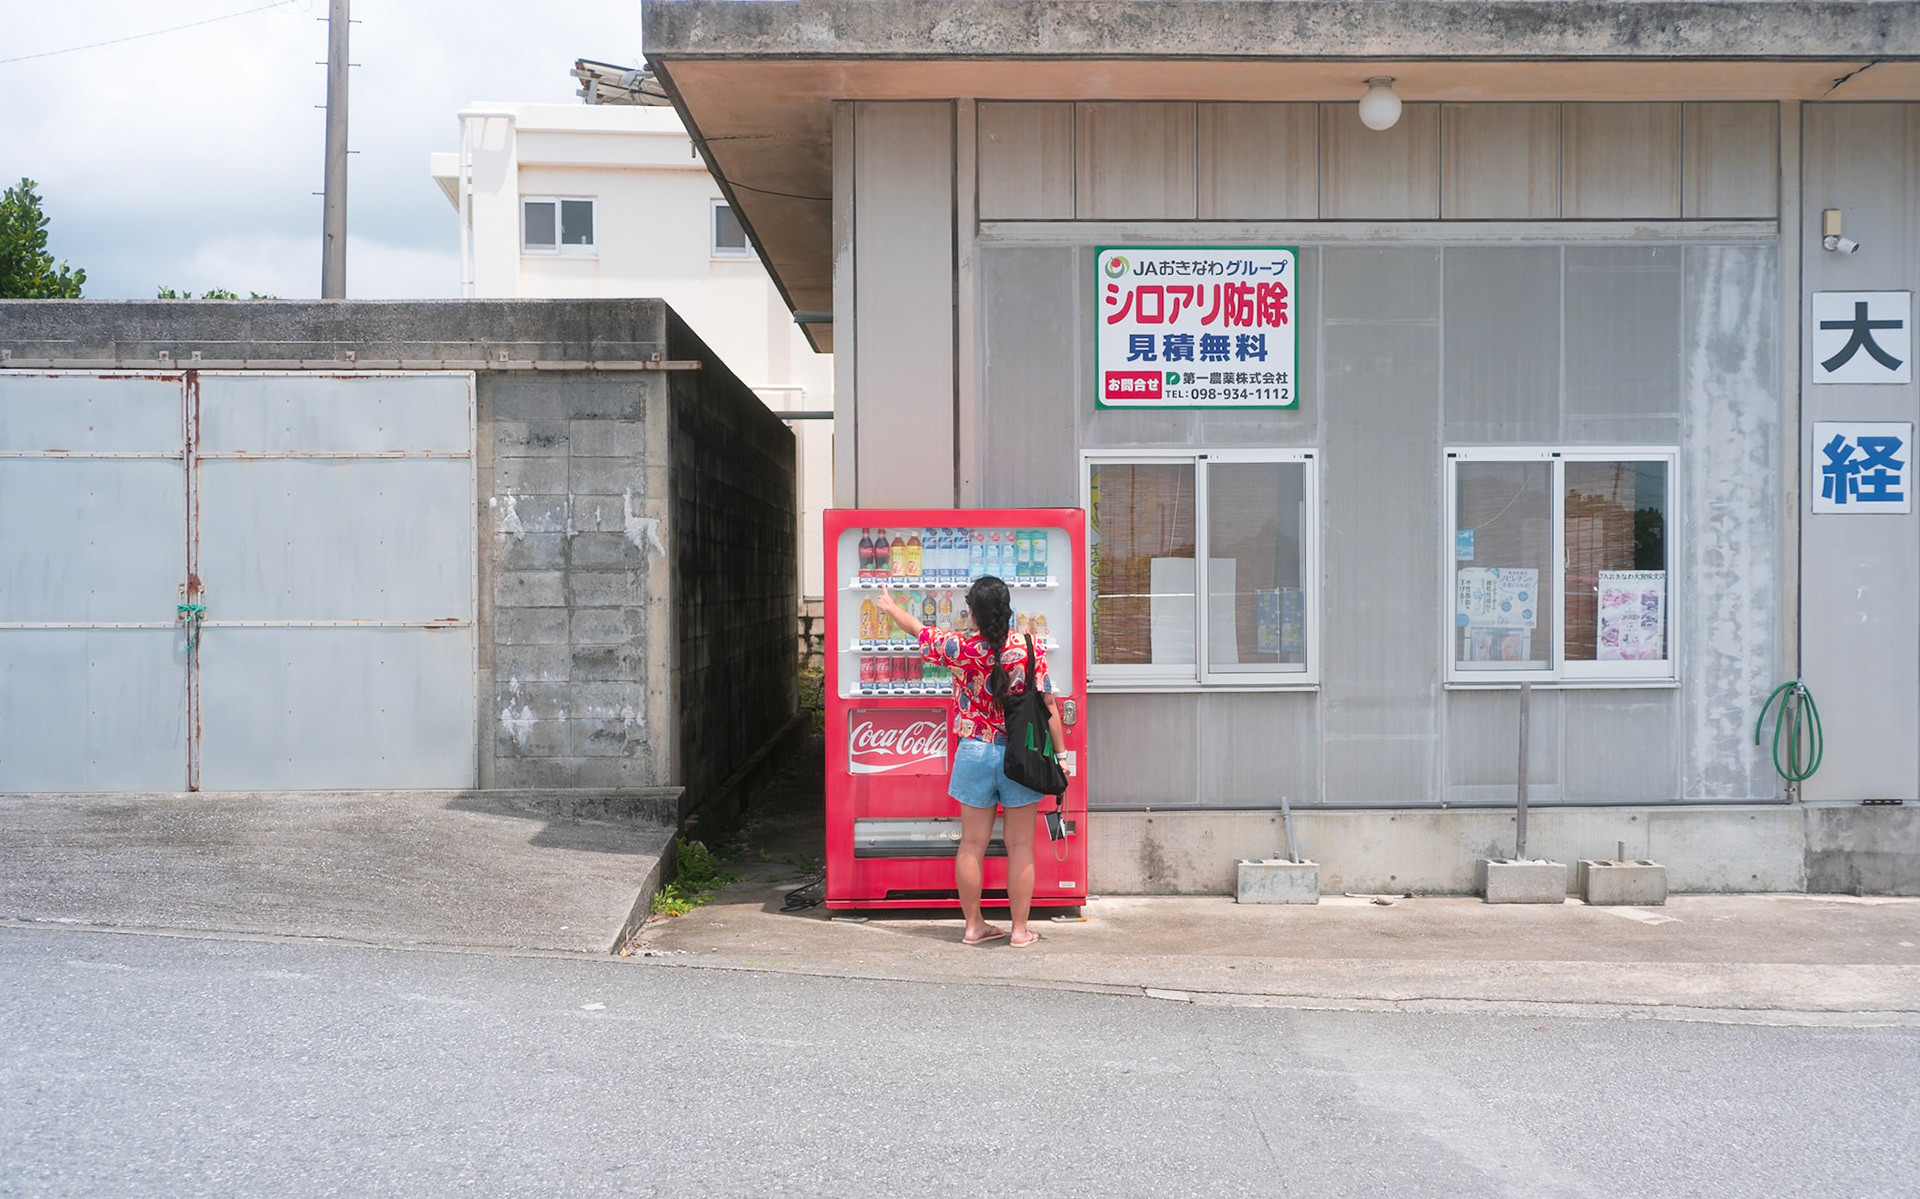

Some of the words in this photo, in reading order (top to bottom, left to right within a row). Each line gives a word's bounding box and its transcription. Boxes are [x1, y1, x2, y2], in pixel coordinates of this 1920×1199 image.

[1133, 259, 1288, 276] JAおきなわグループ
[1105, 281, 1289, 328] シロアリ防除
[1126, 333, 1268, 362] 見積無料
[1820, 302, 1903, 373] 大
[1108, 378, 1160, 392] お問合せ
[1183, 371, 1288, 385] 第一農薬株式会社
[1821, 433, 1905, 504] 経
[851, 721, 947, 755] Coca-Cola
